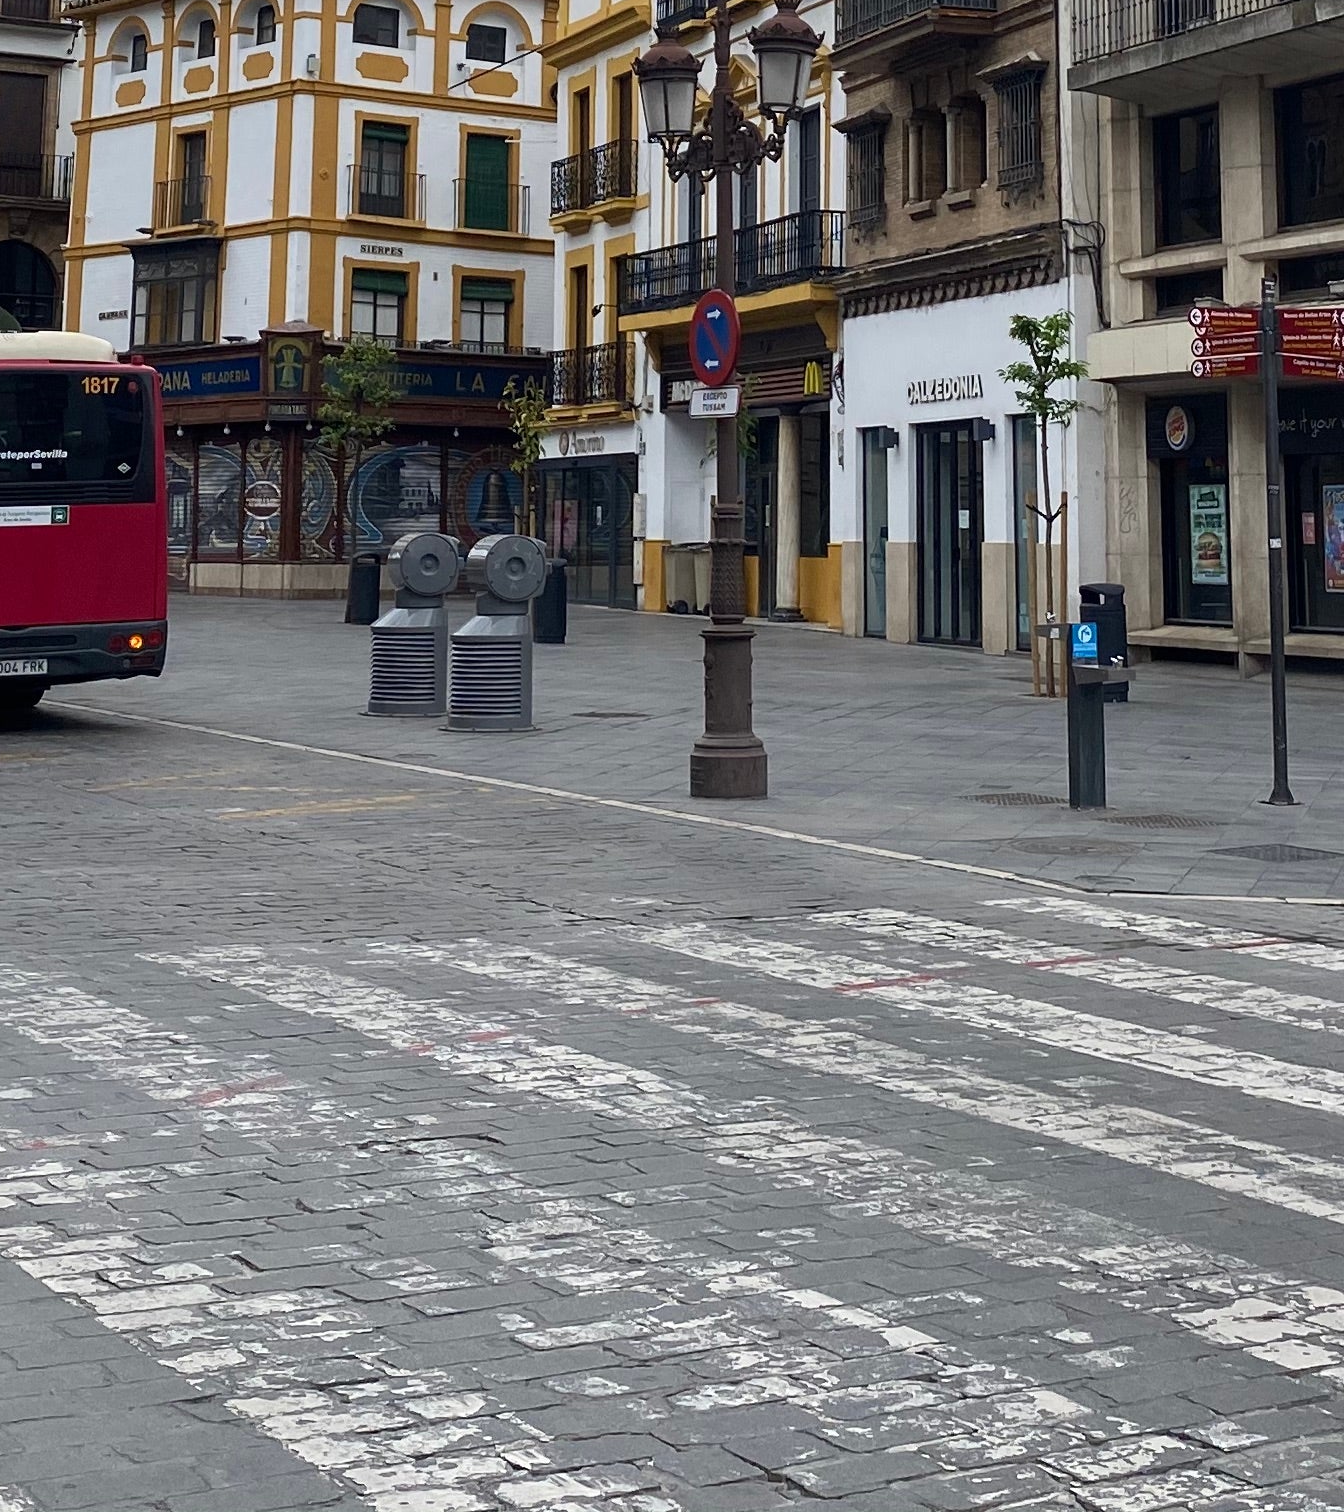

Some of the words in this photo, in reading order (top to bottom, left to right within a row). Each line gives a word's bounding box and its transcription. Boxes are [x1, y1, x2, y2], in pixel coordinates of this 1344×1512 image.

[360, 244, 404, 257] SIERPES
[201, 369, 251, 385] HELADERIA
[81, 376, 120, 395] 1817
[907, 374, 984, 406] CALZEDONIA
[702, 391, 728, 401] EXCEPTO
[702, 403, 726, 411] TUSSAM
[22, 660, 45, 673] FRK
